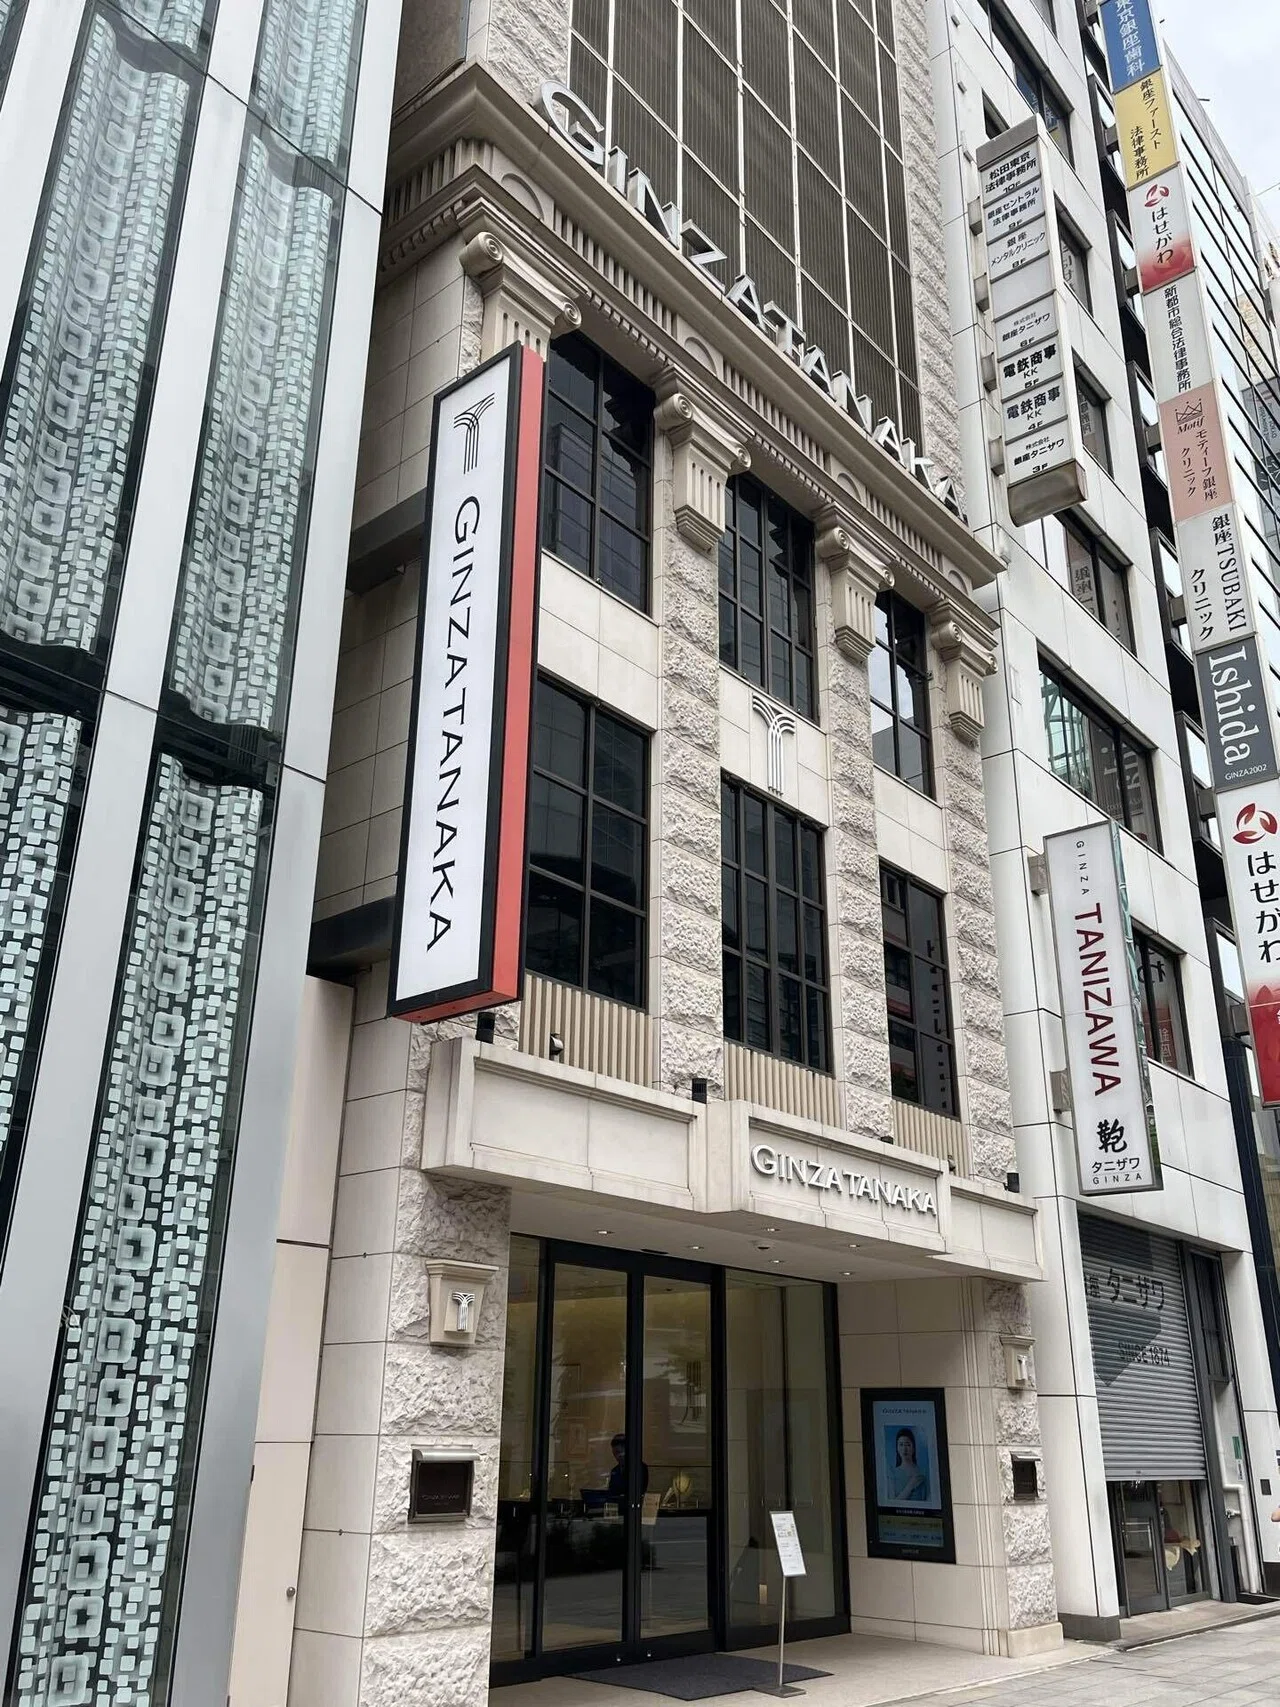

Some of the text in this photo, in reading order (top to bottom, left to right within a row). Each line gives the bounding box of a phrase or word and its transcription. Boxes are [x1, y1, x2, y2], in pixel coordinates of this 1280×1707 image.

[1139, 78, 1162, 150] 銀座ファースト
[989, 151, 1031, 180] 松田東京
[1130, 126, 1150, 181] 法律事務所
[985, 158, 1037, 193] 法律事務所
[991, 232, 1046, 267] メンタルクリニック
[1152, 207, 1174, 263] はせがわ
[537, 79, 966, 520] GINZATANAKA
[1164, 284, 1192, 393] 新都市総合法律事務所
[1003, 344, 1057, 378] 電鉄商事
[1023, 367, 1039, 379] KK
[1006, 385, 1061, 420] 電鉄商事
[1024, 378, 1040, 389] 5F
[1026, 409, 1042, 421] KK
[1028, 420, 1044, 431] 4F
[1177, 416, 1206, 435] Motif
[1032, 463, 1048, 473] 3F
[1182, 447, 1196, 497] クリニック
[1196, 429, 1217, 501] モティーフ銀座
[1211, 513, 1247, 632] 銀座TSUBAKI
[1190, 568, 1216, 642] クリニック
[426, 496, 481, 954] GINZATANAKA
[1208, 646, 1260, 766] Ishida
[1247, 851, 1280, 963] はせがわ
[1074, 840, 1122, 1097] GINZA TANIZAWA
[1096, 1118, 1128, 1153] 鞄
[751, 1144, 937, 1216] GINZATANAKA
[1091, 1157, 1141, 1174] タニザワ
[1092, 1173, 1142, 1185] GINZA
